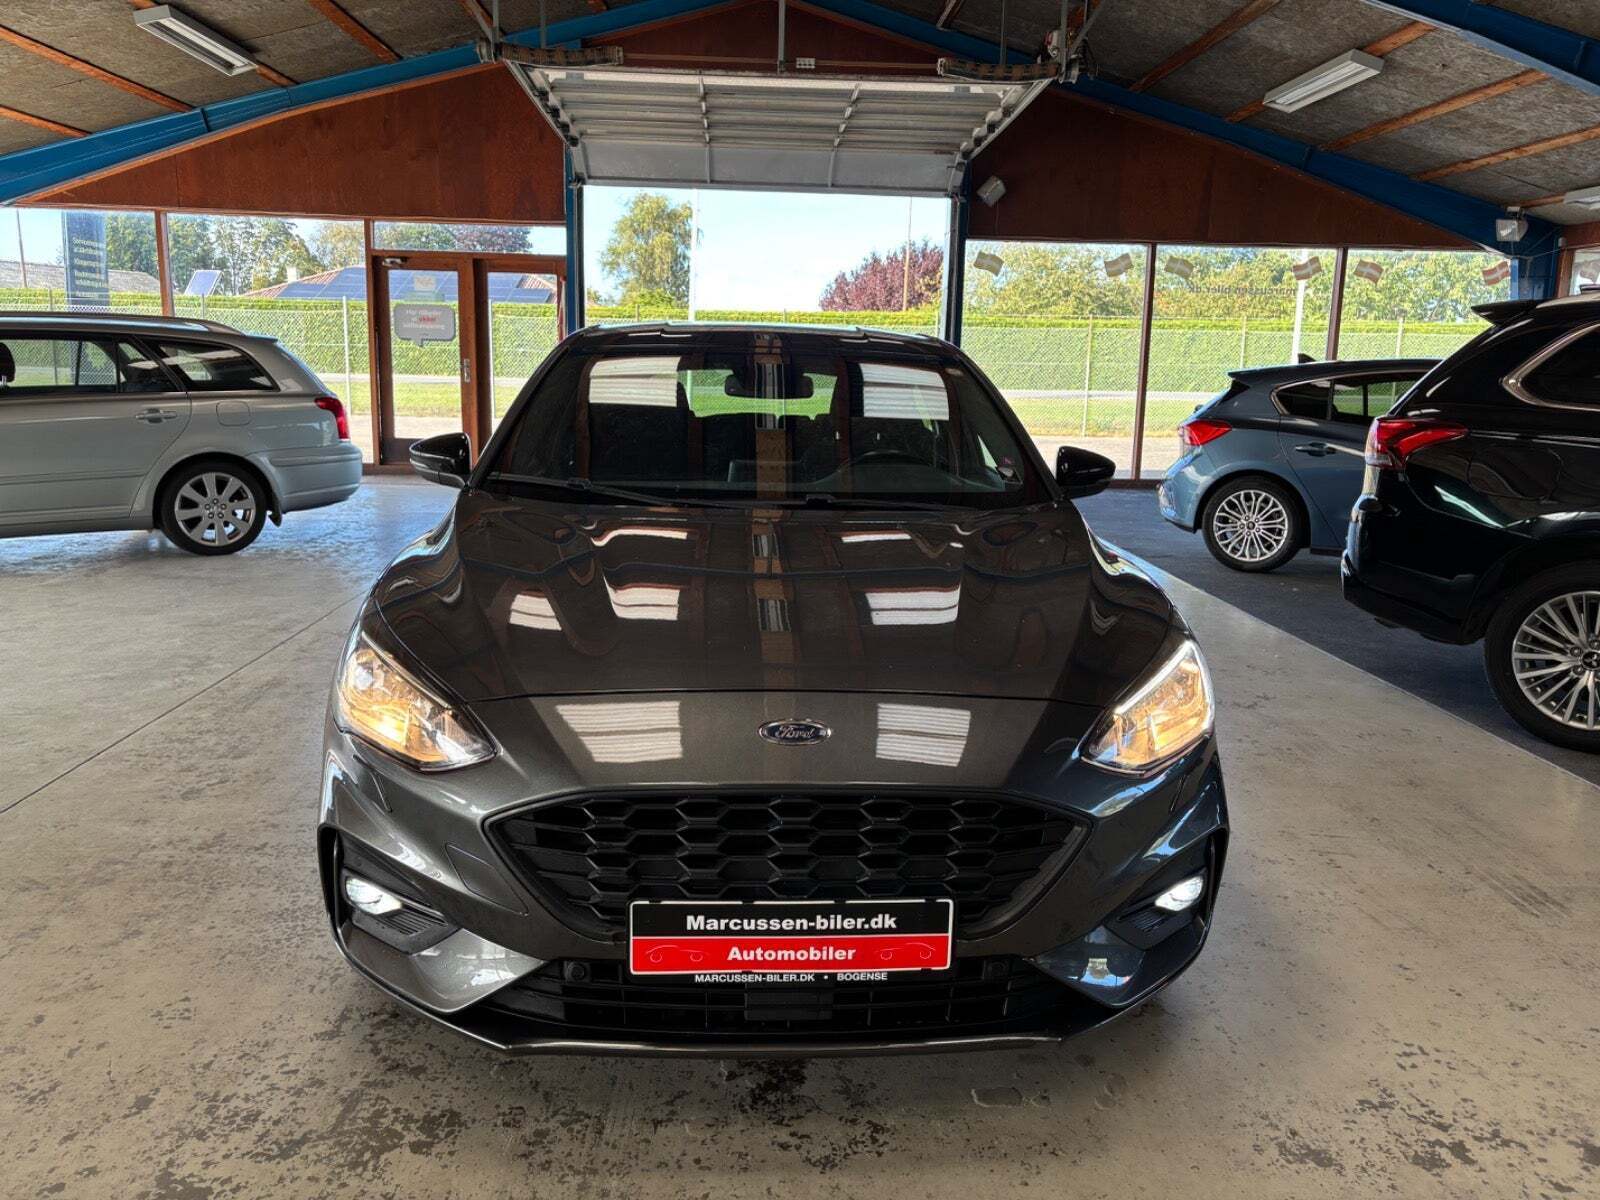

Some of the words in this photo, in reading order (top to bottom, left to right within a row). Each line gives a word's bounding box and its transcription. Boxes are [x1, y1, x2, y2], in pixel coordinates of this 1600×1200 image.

[774, 725, 816, 739] Ford
[686, 914, 897, 931] Marcussen-biler.dk
[726, 946, 857, 961] Automobiler
[695, 973, 816, 983] MARCUSSEN-BILER.DK
[836, 972, 888, 982] BOGENSE
